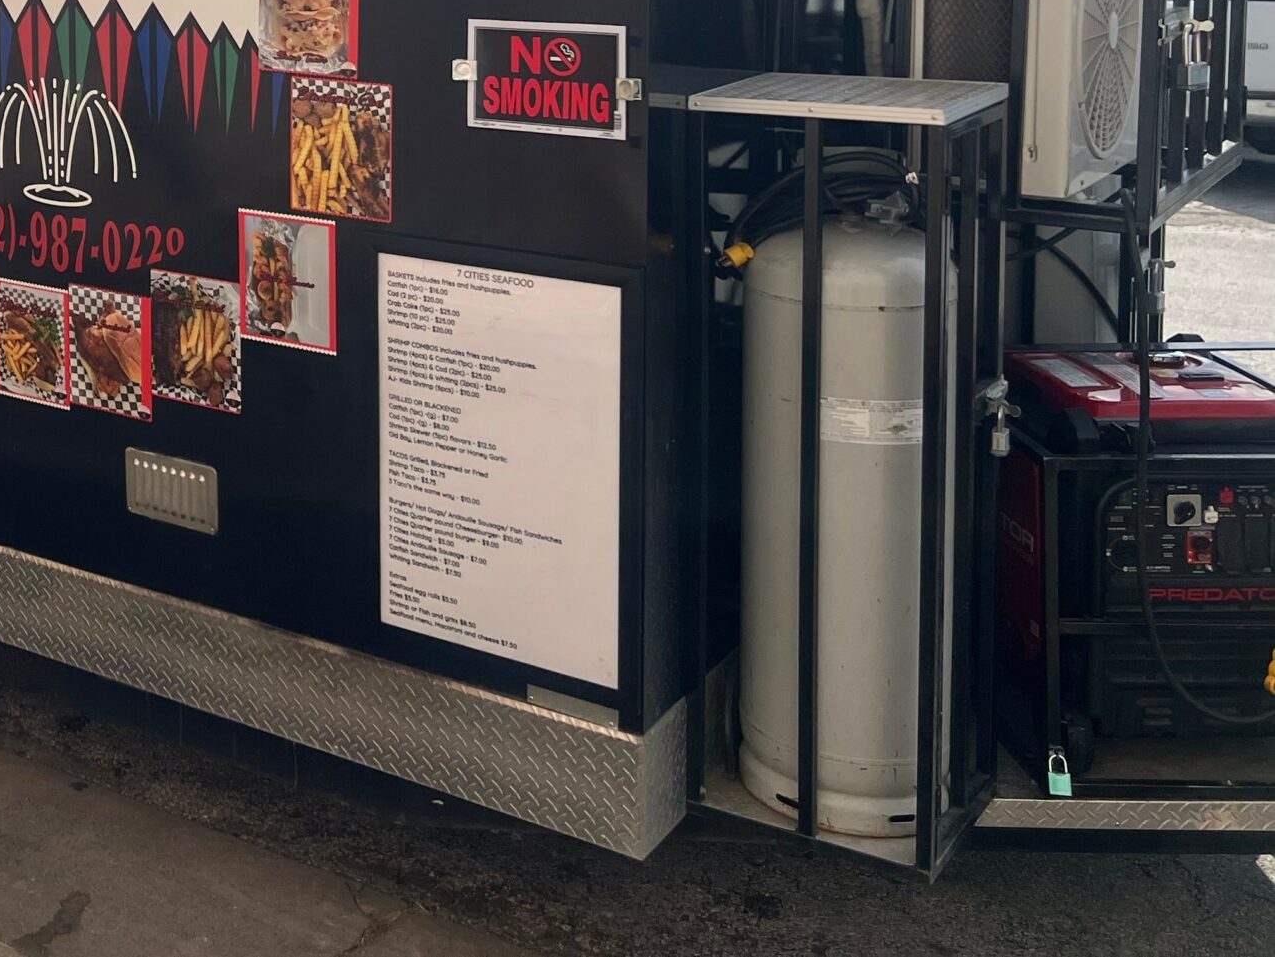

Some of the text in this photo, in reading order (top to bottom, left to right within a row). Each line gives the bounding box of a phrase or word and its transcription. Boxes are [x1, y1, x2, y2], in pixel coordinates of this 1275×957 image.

[483, 75, 610, 123] SMOKING
[387, 280, 408, 289] Catfish
[388, 270, 414, 281] BASKETS
[415, 275, 440, 285] includes
[441, 279, 455, 287] fries
[464, 270, 490, 282] CITIES
[492, 275, 534, 288] SEAFOOD
[387, 299, 402, 307] Crab
[403, 302, 418, 310] Cake
[440, 307, 460, 317] $25.00
[423, 295, 444, 305] $20.00
[387, 308, 408, 319] Shrimp
[435, 316, 455, 326] $25.00
[432, 325, 453, 335] $20.00
[387, 337, 410, 346] SHRIMP
[411, 341, 438, 352] COMBOS
[440, 347, 465, 357] includes
[466, 351, 480, 360] fries
[388, 346, 408, 356] Shrimp
[435, 355, 457, 364] Catfish
[479, 362, 500, 373] $20.00
[388, 356, 408, 366] Shrimp
[435, 365, 447, 373] Cod
[471, 371, 492, 381] $25.00
[388, 365, 408, 375] Shrimp
[485, 383, 506, 394] $25.00
[412, 380, 434, 390] Shrimp
[389, 394, 413, 404] GRILLED
[424, 401, 462, 415] BLACKENED
[389, 403, 408, 412] Catfish
[442, 414, 459, 424] $7.00
[389, 412, 400, 420] Cod
[389, 422, 408, 432] Shrimp
[410, 427, 431, 436] Skewer
[449, 435, 472, 446] flavors
[413, 437, 434, 447] Lemon
[435, 442, 457, 452] Pepper
[467, 448, 488, 460] Honey
[389, 450, 408, 460] TACOS
[430, 460, 463, 473] Blackened
[472, 469, 489, 479] Fried
[389, 459, 425, 474] Shrimp Taco
[389, 468, 416, 481] Fish Taco
[424, 488, 441, 496] same
[442, 492, 455, 501] way
[393, 507, 409, 516] Cities
[410, 511, 433, 522] Quarter
[434, 519, 454, 528] pound
[393, 517, 409, 526] Cities
[410, 521, 433, 532] Quarter
[434, 529, 454, 538] pound
[455, 532, 476, 543] burger
[393, 526, 409, 535] Cities
[510, 526, 522, 535] Fish
[389, 543, 460, 568] Catfish Sandwich $7.00
[393, 535, 409, 545] Cities
[438, 547, 465, 560] Sausage
[470, 555, 487, 566] $7.00
[389, 571, 407, 582] Extras
[412, 559, 462, 578] Sandwich $7.50
[389, 580, 440, 600] Seafood egg rolls
[390, 590, 403, 599] Fries
[390, 599, 410, 610] Shrimp
[418, 607, 430, 616] Fish
[390, 608, 414, 620] Seafood
[434, 621, 463, 634] Macaroni
[477, 634, 500, 645] cheese
[501, 639, 517, 650] $7.50
